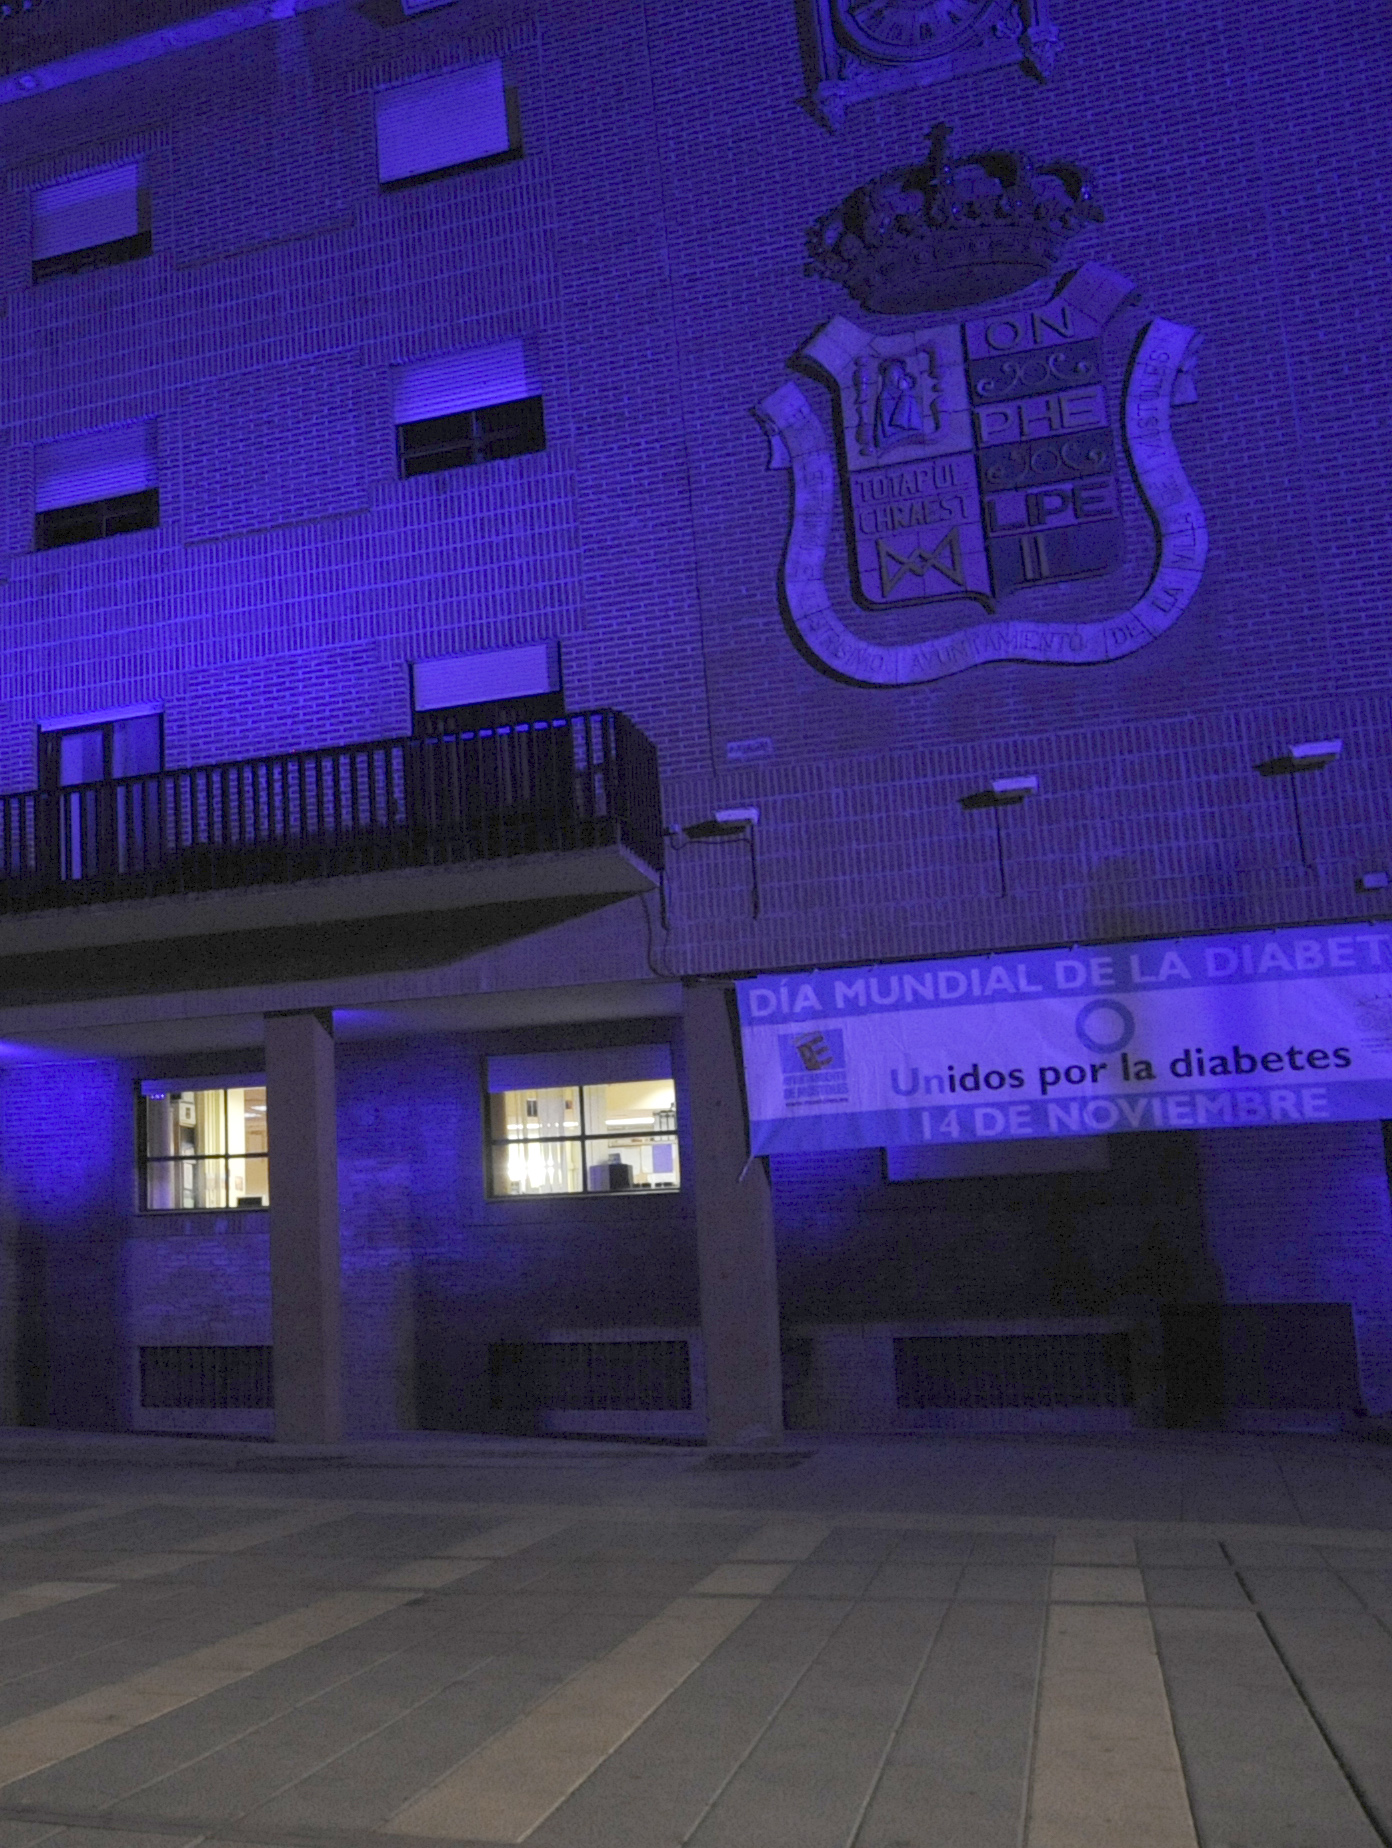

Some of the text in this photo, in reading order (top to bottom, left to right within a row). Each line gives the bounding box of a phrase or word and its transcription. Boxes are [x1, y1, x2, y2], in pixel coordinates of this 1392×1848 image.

[976, 393, 1100, 443] PHE
[985, 480, 1111, 531] LIPE
[1151, 586, 1185, 614] LA
[750, 978, 822, 1019] DÍA
[835, 962, 1043, 1011] MUNDIAL
[1055, 956, 1115, 993] DE
[1131, 950, 1191, 984] LA
[890, 1063, 1025, 1097] Unidos
[1039, 1061, 1107, 1096] por
[1121, 1052, 1156, 1082] la
[1170, 1045, 1352, 1079] diabetes
[921, 1087, 1331, 1140] 14 DE NOVIEMBRE
